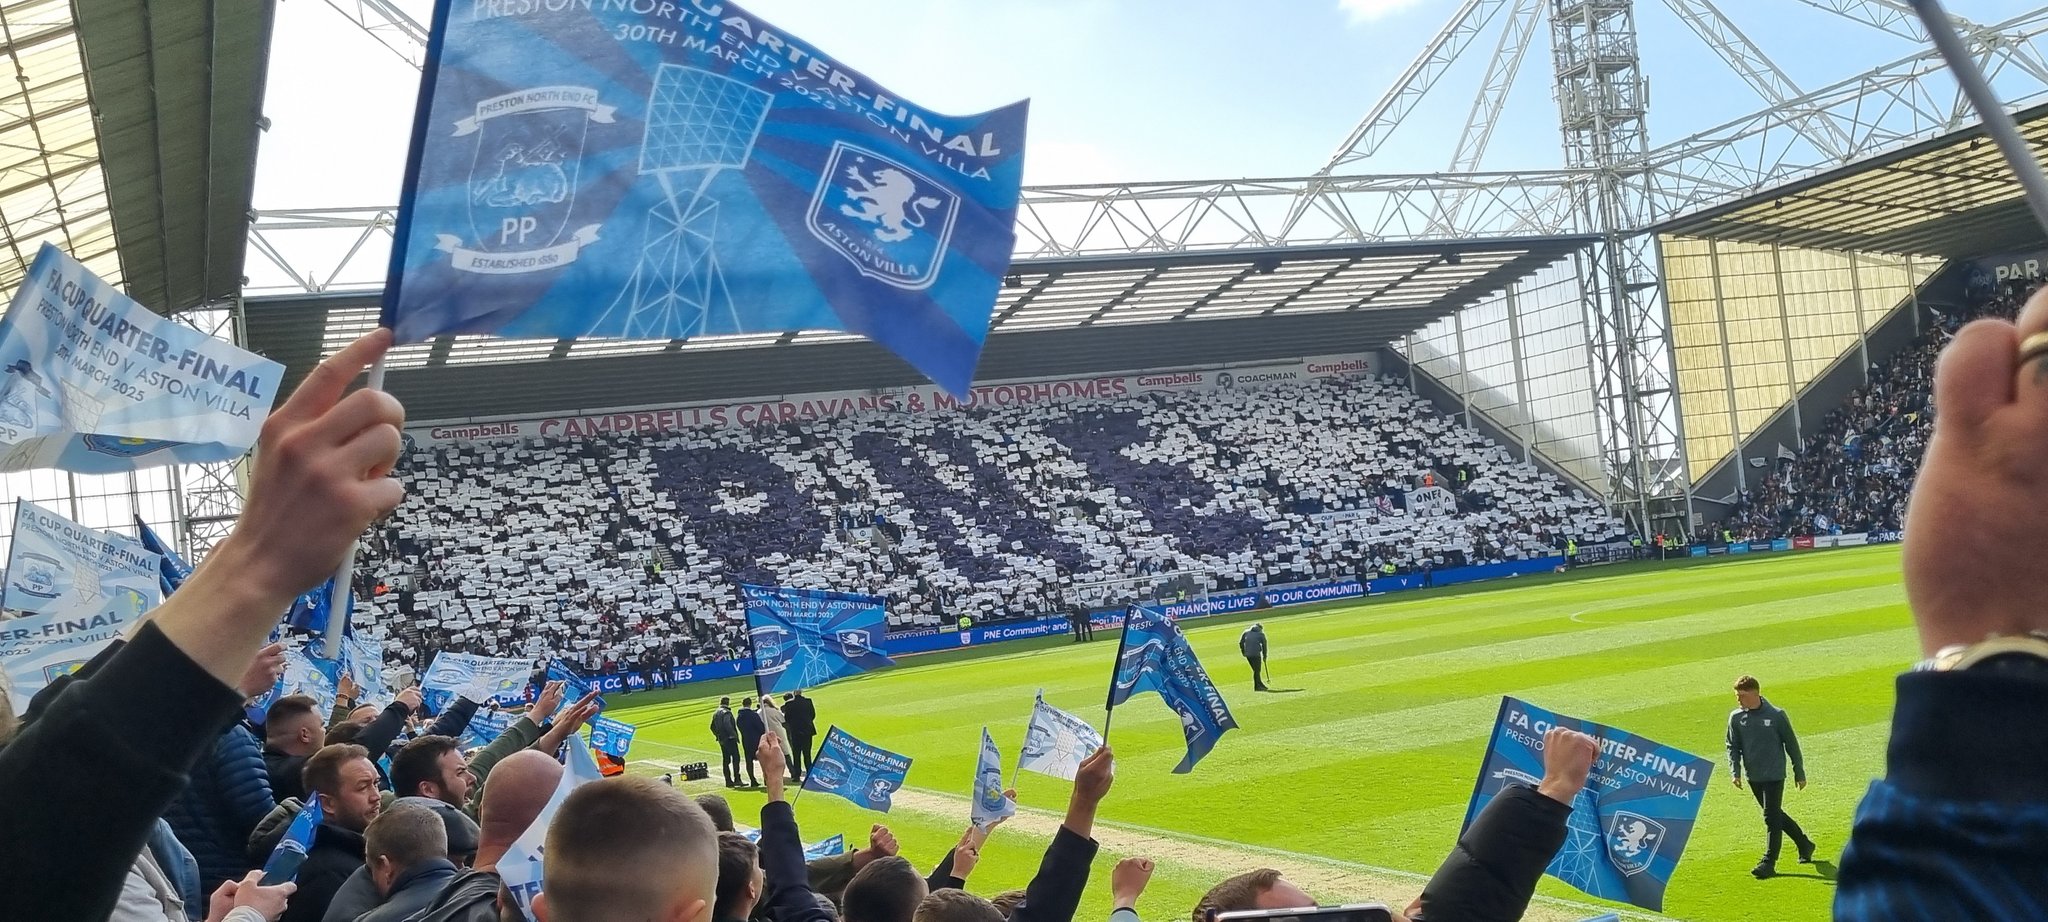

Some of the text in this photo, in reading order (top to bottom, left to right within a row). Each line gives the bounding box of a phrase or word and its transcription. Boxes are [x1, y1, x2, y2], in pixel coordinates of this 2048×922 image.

[614, 23, 837, 111] 30TH MARCH 2025
[691, 0, 1001, 157] UARTER-FINAL
[602, 0, 712, 32] NORTH
[720, 31, 782, 69] END
[791, 68, 809, 82] V
[816, 86, 911, 144] ASTON
[920, 140, 992, 182] VILLA
[480, 97, 524, 116] PRESTON
[501, 216, 537, 245] PP
[823, 222, 920, 276] ASTON VILLA
[471, 257, 537, 269] ESTABLISHED
[47, 269, 263, 400] FA CUP QUARTER-FINAL
[1306, 359, 1369, 374] Campbells
[72, 355, 112, 388] MARCH
[111, 378, 146, 402] 2025
[90, 341, 120, 367] END
[123, 358, 136, 374] V
[135, 367, 200, 403] ASTON
[204, 391, 251, 421] VILLA
[1136, 372, 1203, 388] Campbells
[1237, 371, 1298, 383] COACHMAN
[736, 394, 895, 428] CARAVANS
[907, 392, 926, 414] &
[430, 422, 520, 441] Campbells
[21, 508, 36, 524] FA
[39, 515, 62, 536] CUP
[63, 526, 155, 573] QUARTER-FINAL
[32, 583, 44, 591] PP
[1401, 578, 1407, 586] V
[771, 599, 799, 609] NORTH
[827, 602, 856, 610] ASTON
[1165, 596, 1256, 617] ENHANCING LIVES
[1282, 591, 1303, 603] OUR
[0, 611, 123, 642] ER-FINAL
[78, 629, 124, 644] VILLA
[983, 629, 1001, 640] PNE
[1003, 624, 1051, 638] Community
[1052, 622, 1068, 631] and
[733, 663, 741, 672] V
[762, 659, 773, 667] PP
[1508, 710, 1529, 730] FA
[1505, 728, 1544, 751] PRESTO
[830, 731, 839, 741] FA
[839, 737, 855, 749] CUP
[854, 745, 908, 769] QUARTER-FINAL
[1600, 775, 1621, 790] 2025
[1606, 761, 1615, 772] V
[1614, 766, 1658, 789] ASTON
[1660, 780, 1690, 801] VILLA
